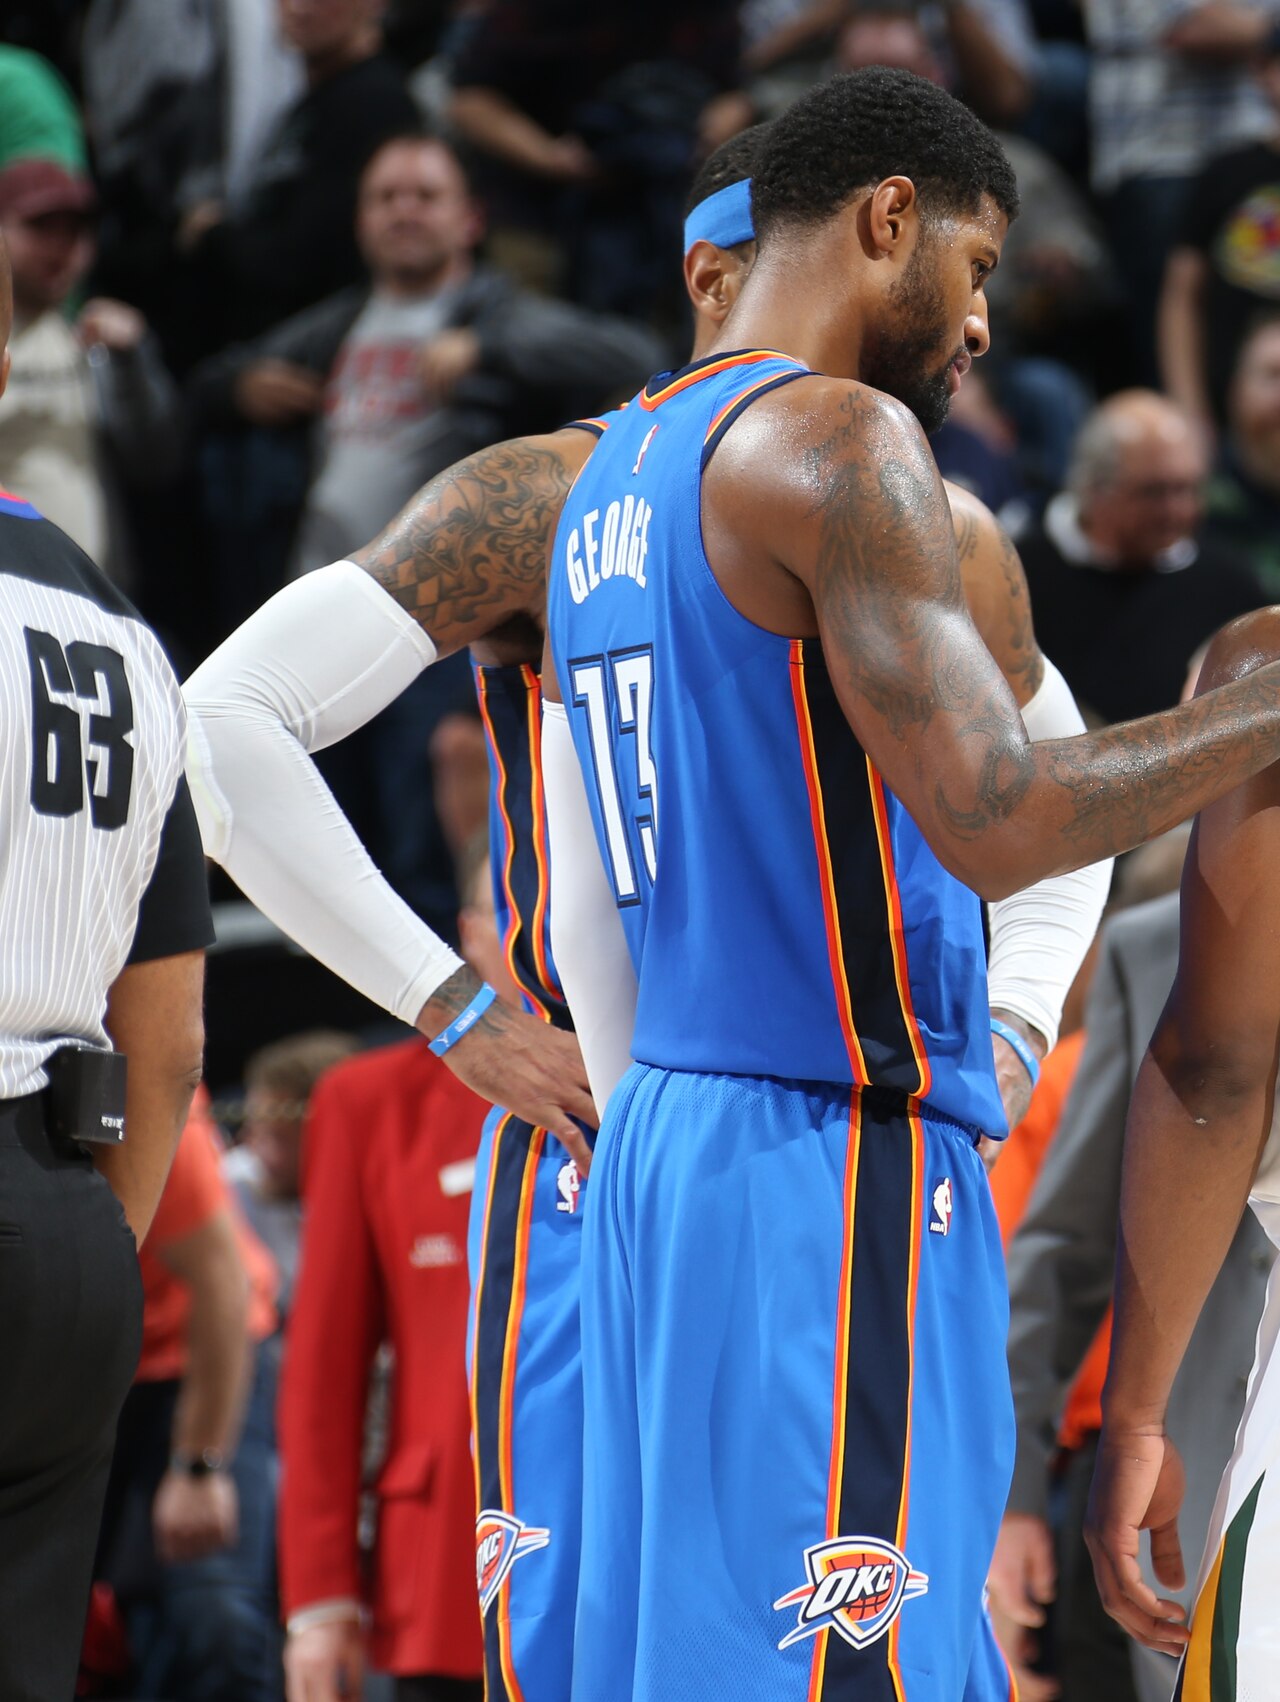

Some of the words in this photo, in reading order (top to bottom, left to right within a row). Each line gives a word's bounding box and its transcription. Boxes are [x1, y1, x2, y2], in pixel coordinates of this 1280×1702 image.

[566, 494, 652, 604] GEORGE
[23, 625, 135, 831] 63
[568, 643, 657, 908] 13
[930, 1221, 945, 1233] NBA
[804, 1563, 895, 1620] OKC
